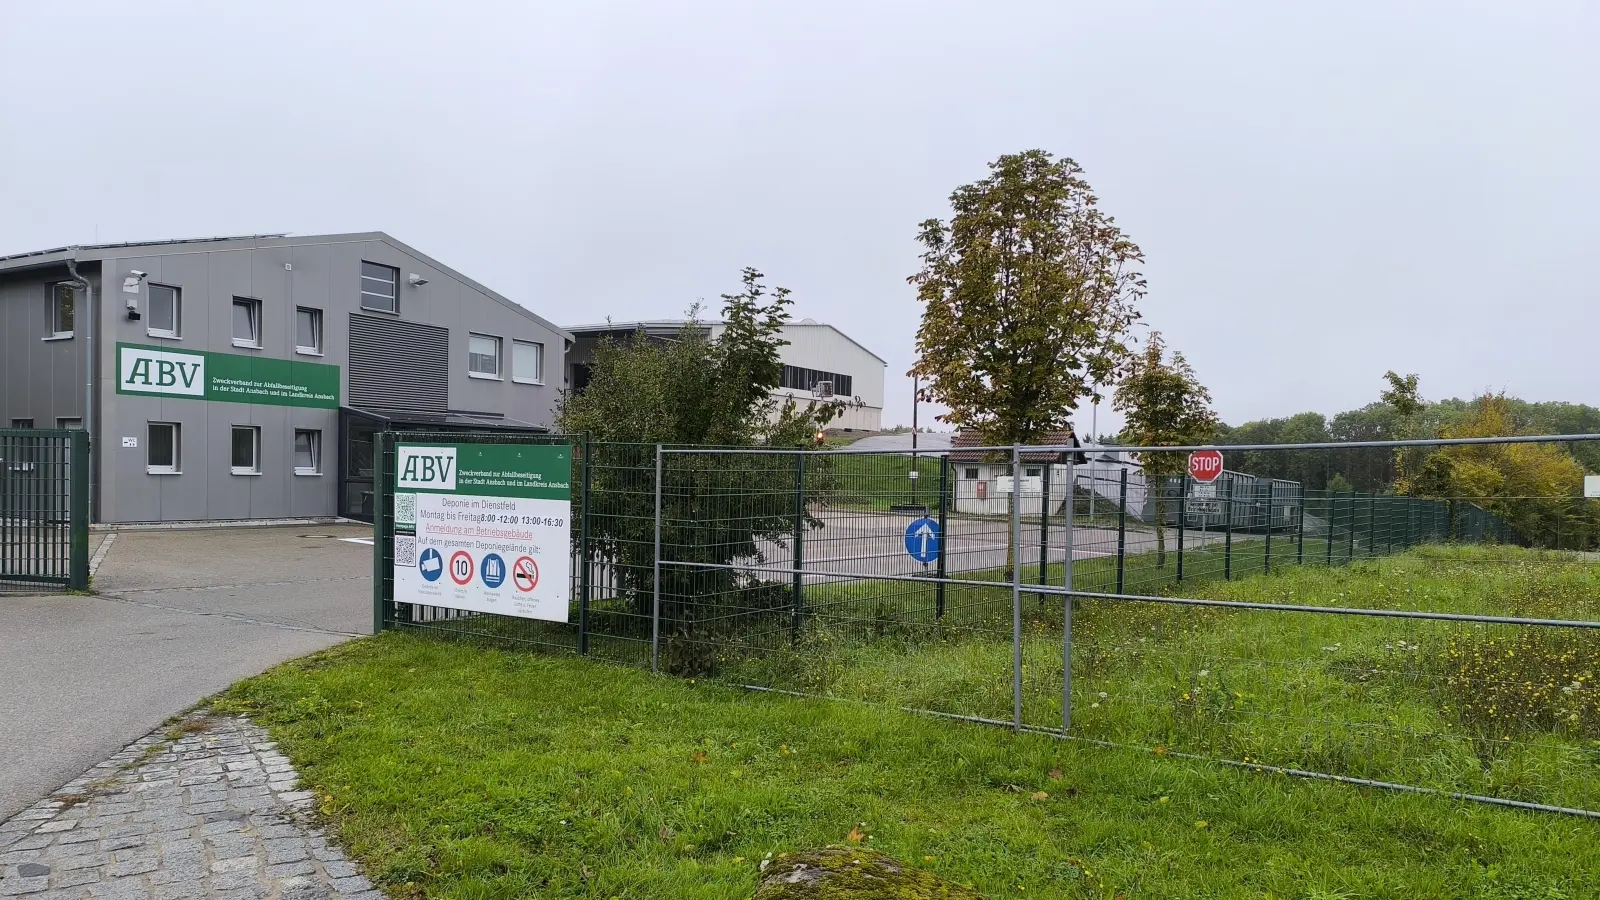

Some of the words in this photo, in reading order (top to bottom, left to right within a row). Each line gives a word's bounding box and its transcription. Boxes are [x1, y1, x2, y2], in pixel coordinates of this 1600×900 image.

[125, 357, 200, 389] ABV
[212, 376, 253, 387] Zweckverband
[254, 380, 263, 388] zur
[263, 380, 308, 393] Abfallbeseitigung
[230, 386, 245, 394] Stadt
[245, 387, 269, 396] Ansbach
[269, 389, 281, 397] und
[288, 391, 314, 400] Landkreis
[314, 392, 335, 401] Ansbach
[400, 455, 454, 483] ABV
[1192, 457, 1220, 471] STOP
[458, 469, 492, 478] Zweckverband
[501, 471, 542, 481] Abfallbeseitigung
[486, 479, 506, 487] Ansbach
[523, 480, 547, 488] Landkreis
[547, 481, 570, 489] Ansbach
[442, 497, 470, 509] Deponie
[471, 499, 480, 509] im
[481, 499, 516, 511] Dienstfeld
[420, 509, 445, 522] Montag
[446, 511, 457, 521] bis
[480, 513, 496, 523] 8:00
[425, 523, 462, 536] Anmeldung
[463, 527, 475, 535] am
[476, 525, 533, 540] Betriebsgebäude
[417, 536, 428, 545] Auf
[428, 537, 443, 547] dem
[443, 540, 475, 549] gesamten
[475, 540, 527, 554] Deponiegelände
[528, 544, 541, 556] gilt:
[455, 559, 469, 577] 10
